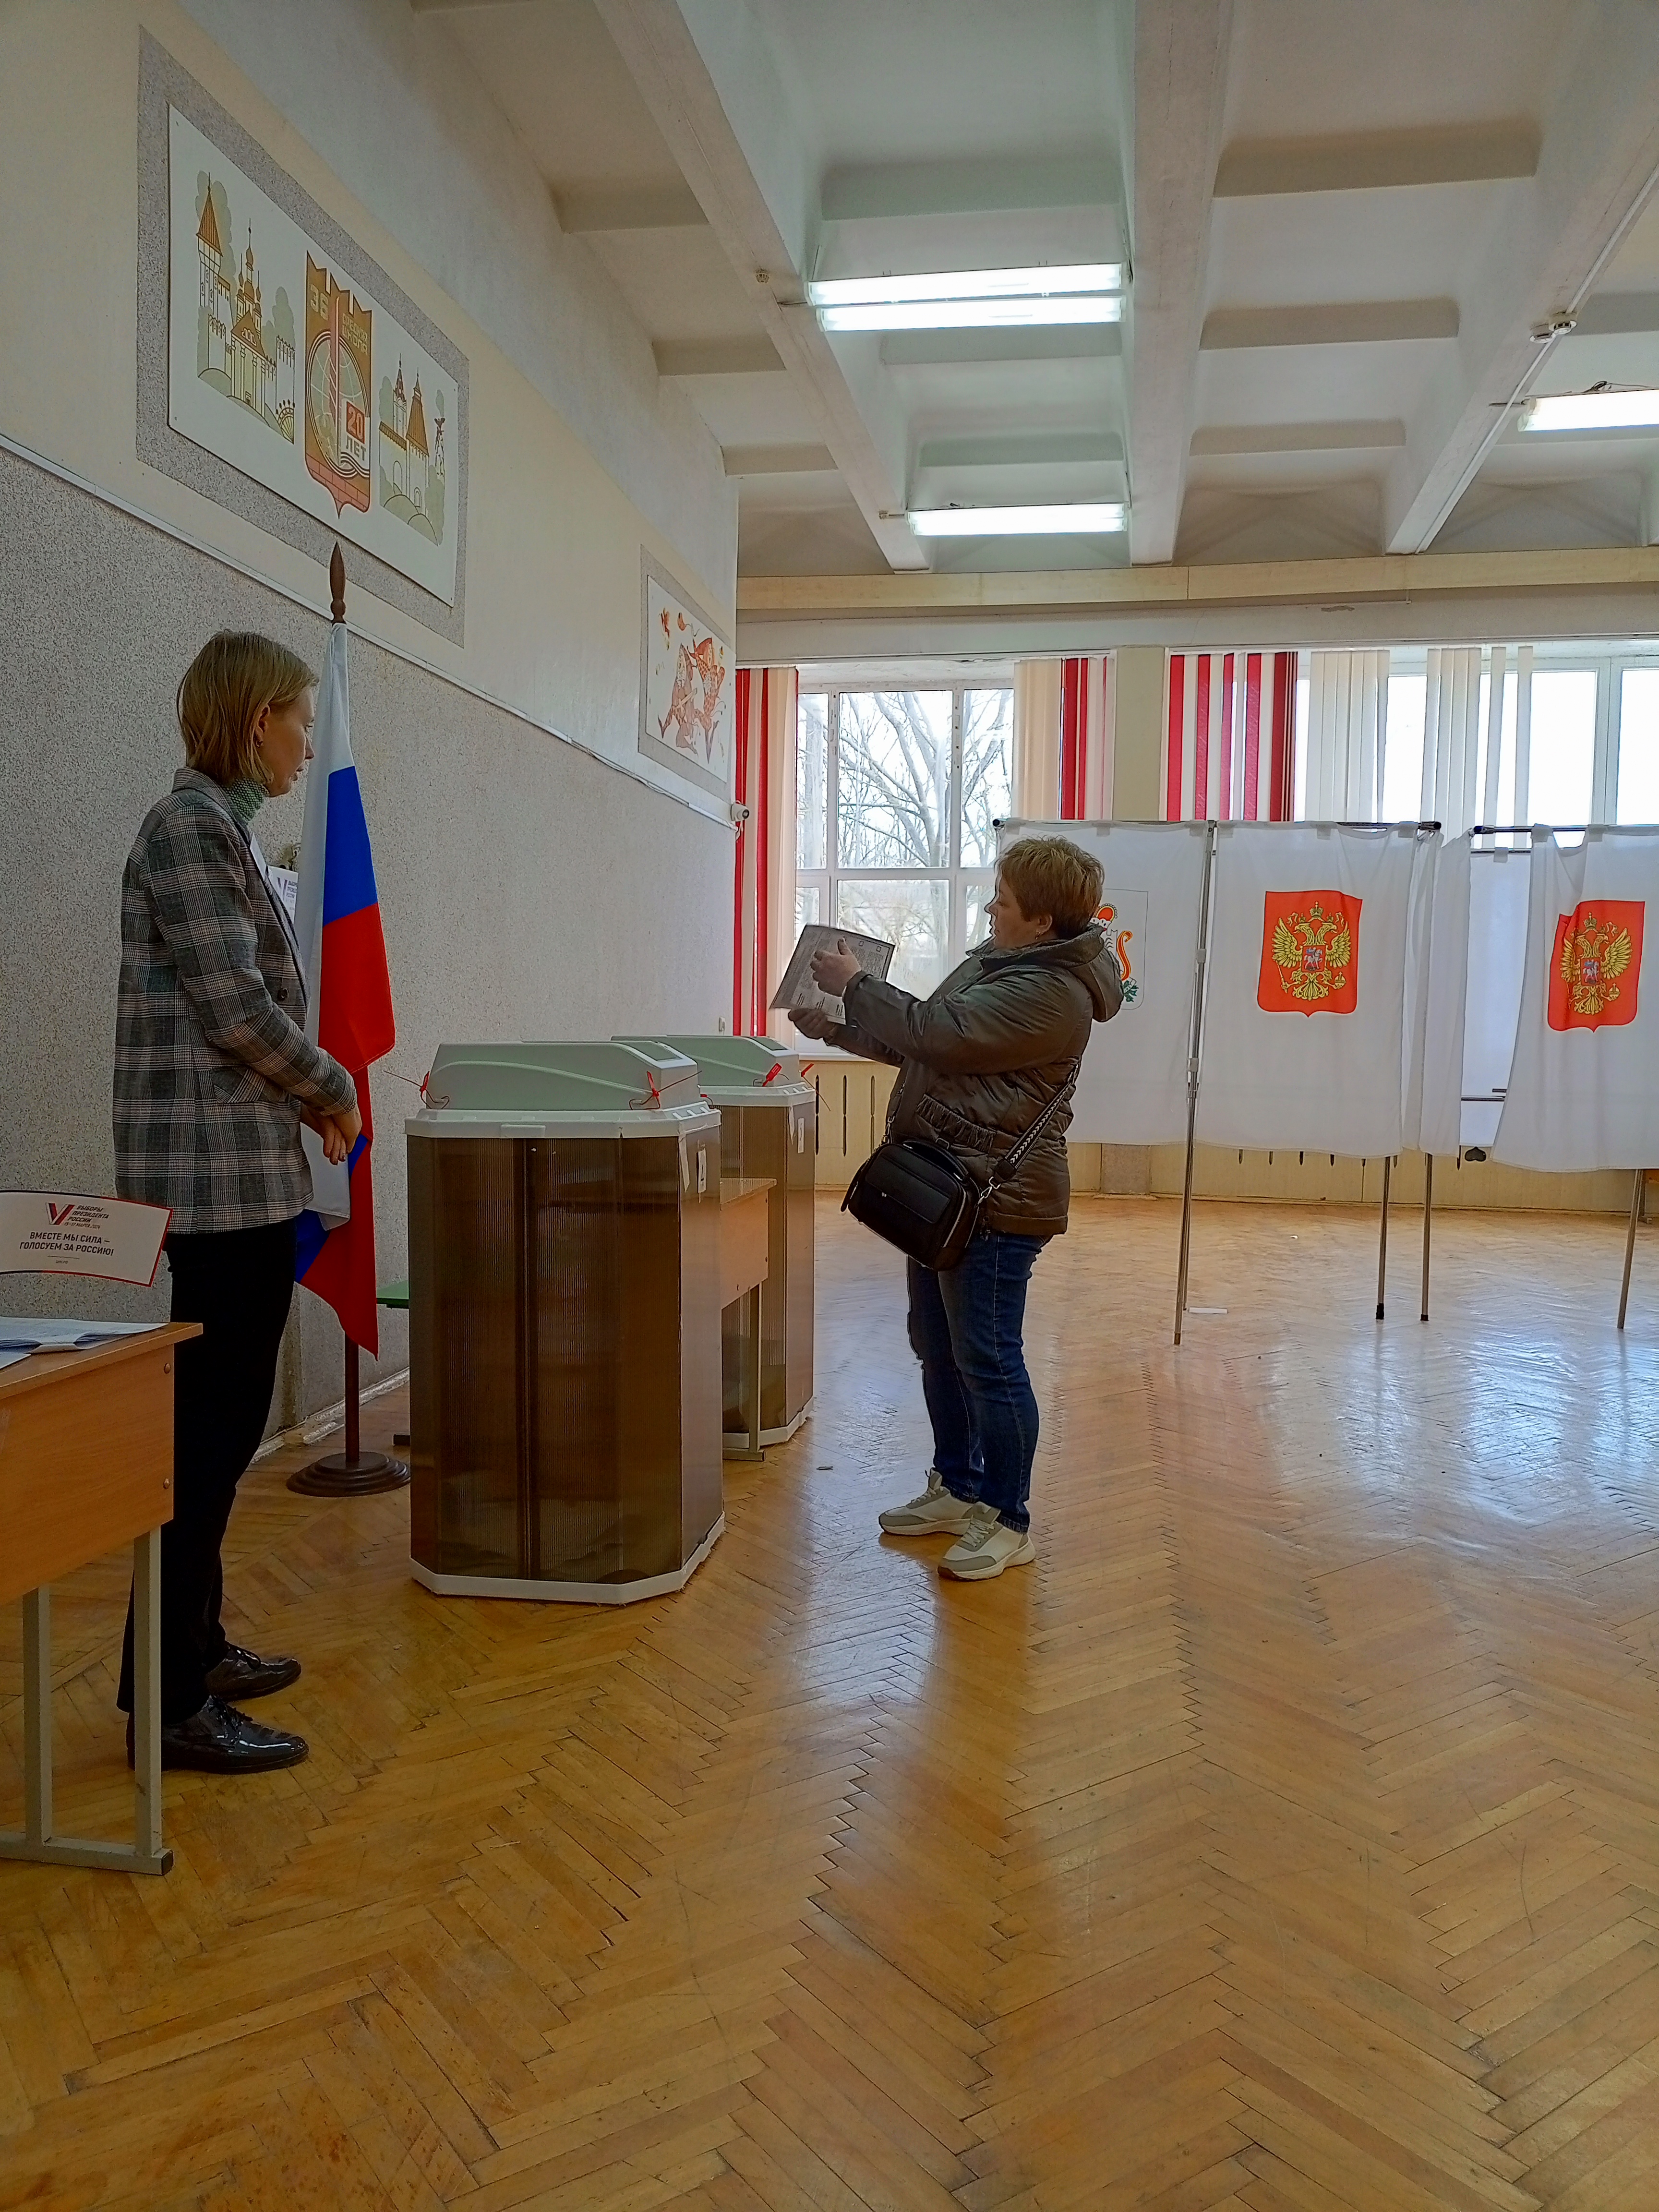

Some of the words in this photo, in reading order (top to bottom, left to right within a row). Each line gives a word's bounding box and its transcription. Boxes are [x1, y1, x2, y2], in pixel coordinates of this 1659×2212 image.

[342, 324, 368, 356] ШКОЛА
[348, 406, 363, 440] 20
[346, 435, 366, 461] ЛЕТ
[72, 1211, 109, 1219] ПРЕЗИДЕНТА
[30, 1232, 62, 1240] ВМЕСТЕ
[80, 1235, 102, 1244] СИЛА
[19, 1242, 62, 1250] ГОЛОСУЕМ
[75, 1244, 114, 1256] РОССИЮ!
